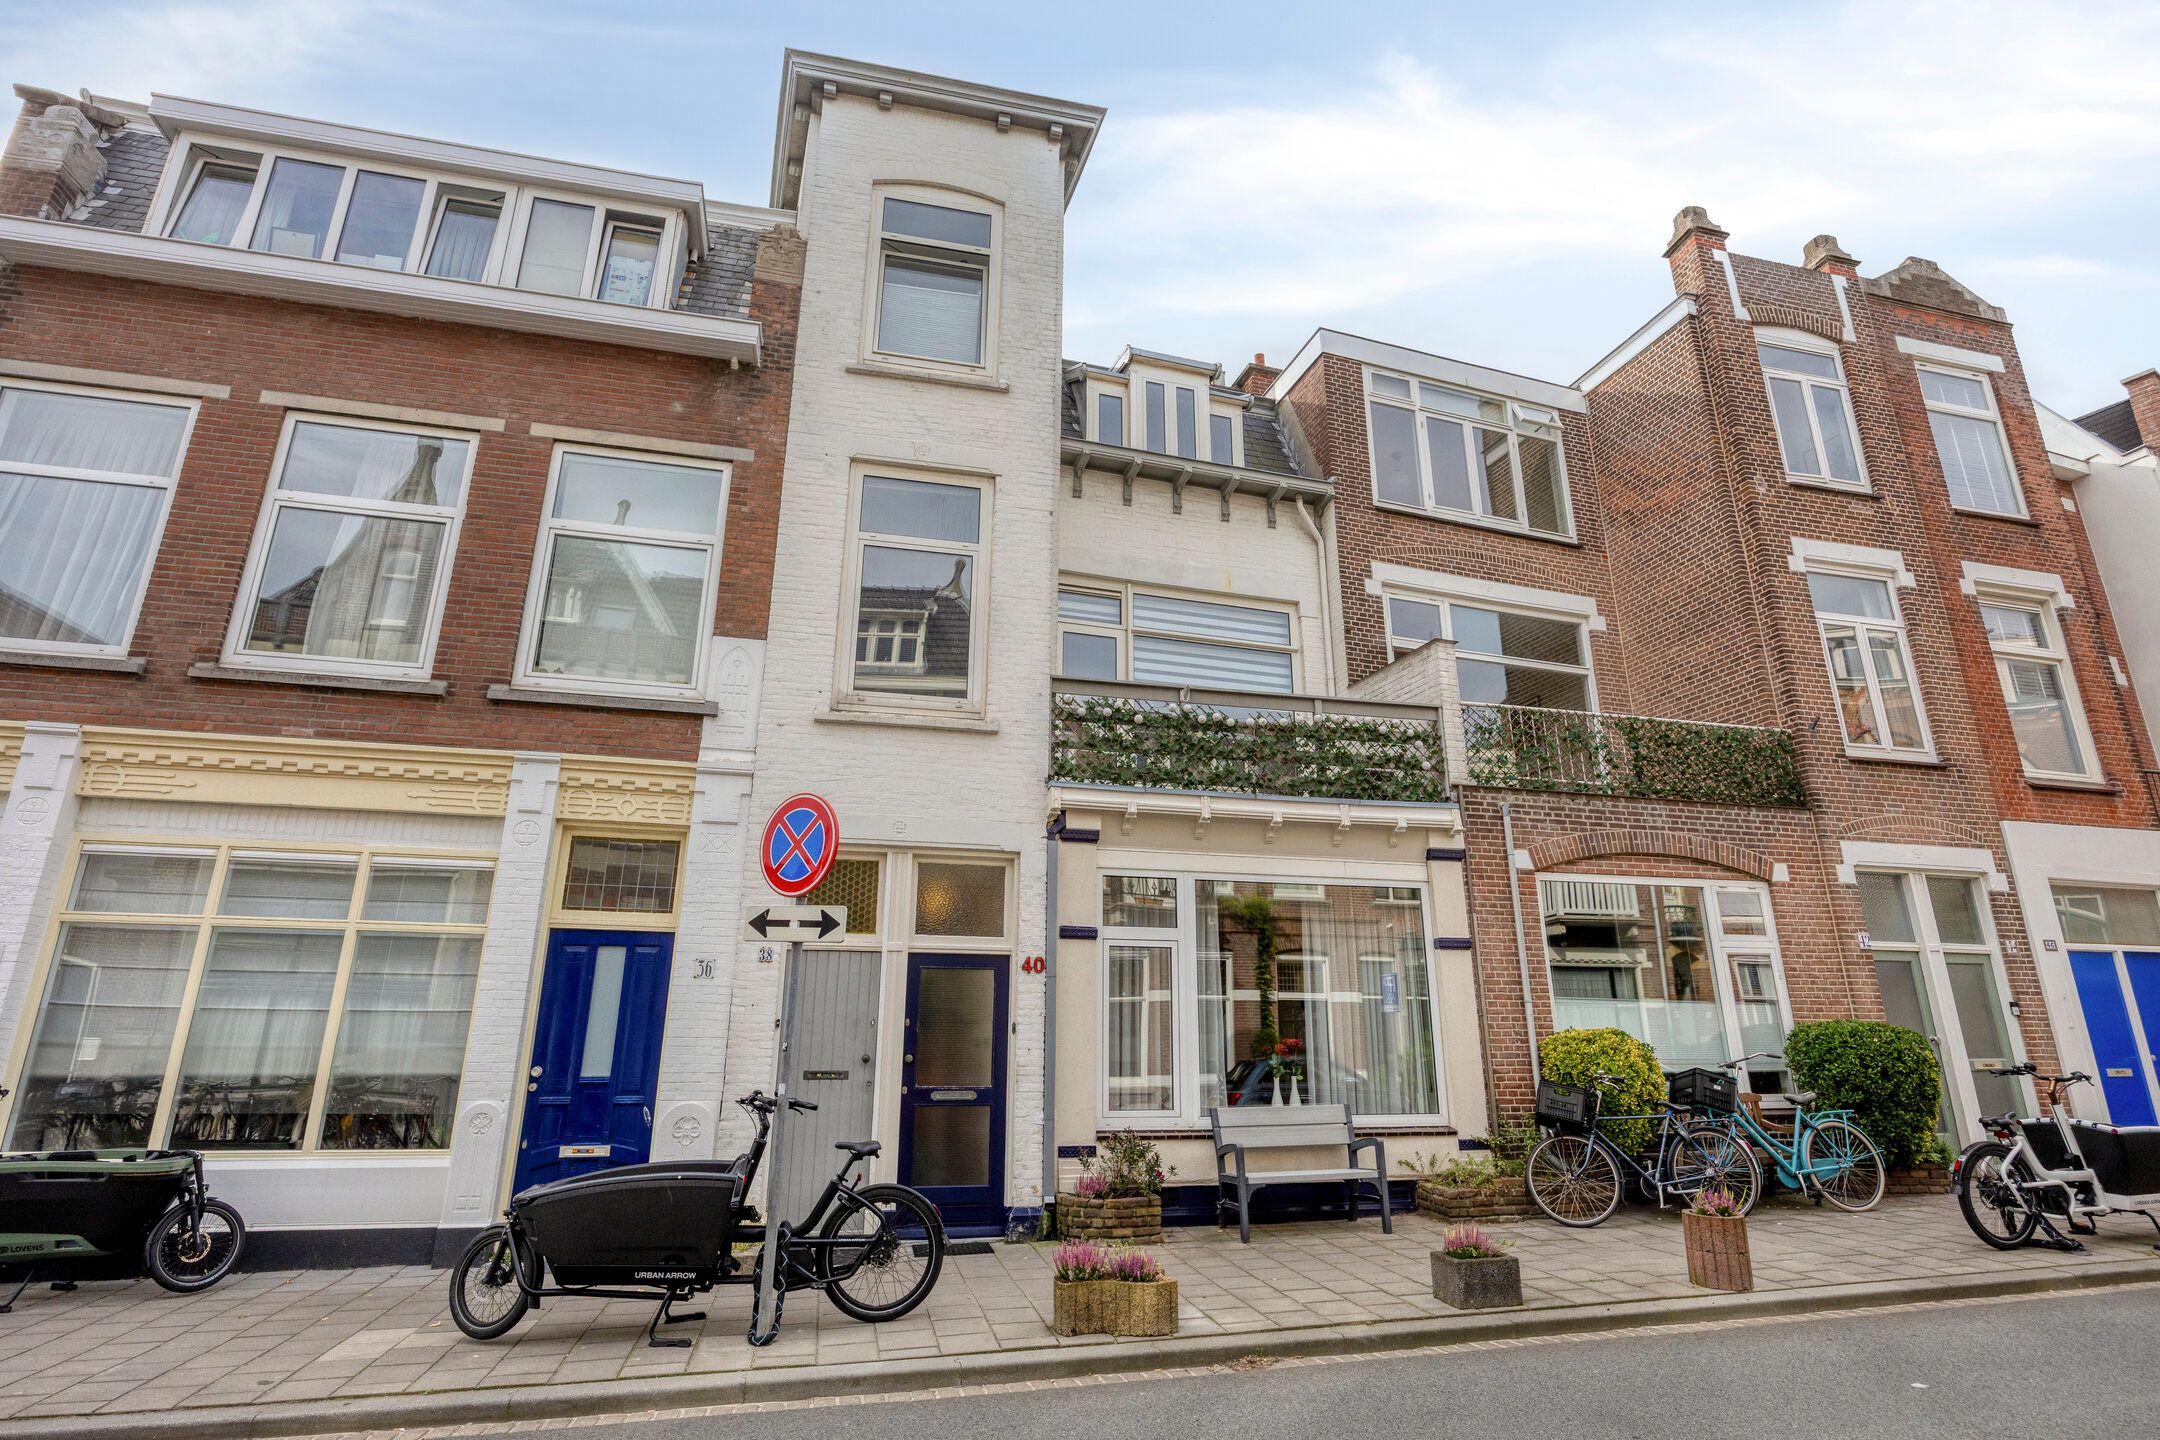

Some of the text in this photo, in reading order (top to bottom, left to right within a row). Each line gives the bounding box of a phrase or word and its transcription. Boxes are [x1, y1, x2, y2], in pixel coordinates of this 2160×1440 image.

[1860, 935, 1872, 947] 42
[759, 946, 773, 963] 38
[697, 960, 713, 977] 36
[1022, 956, 1045, 974] 40
[10, 1244, 45, 1253] LOVENS
[634, 1271, 665, 1279] URBAN
